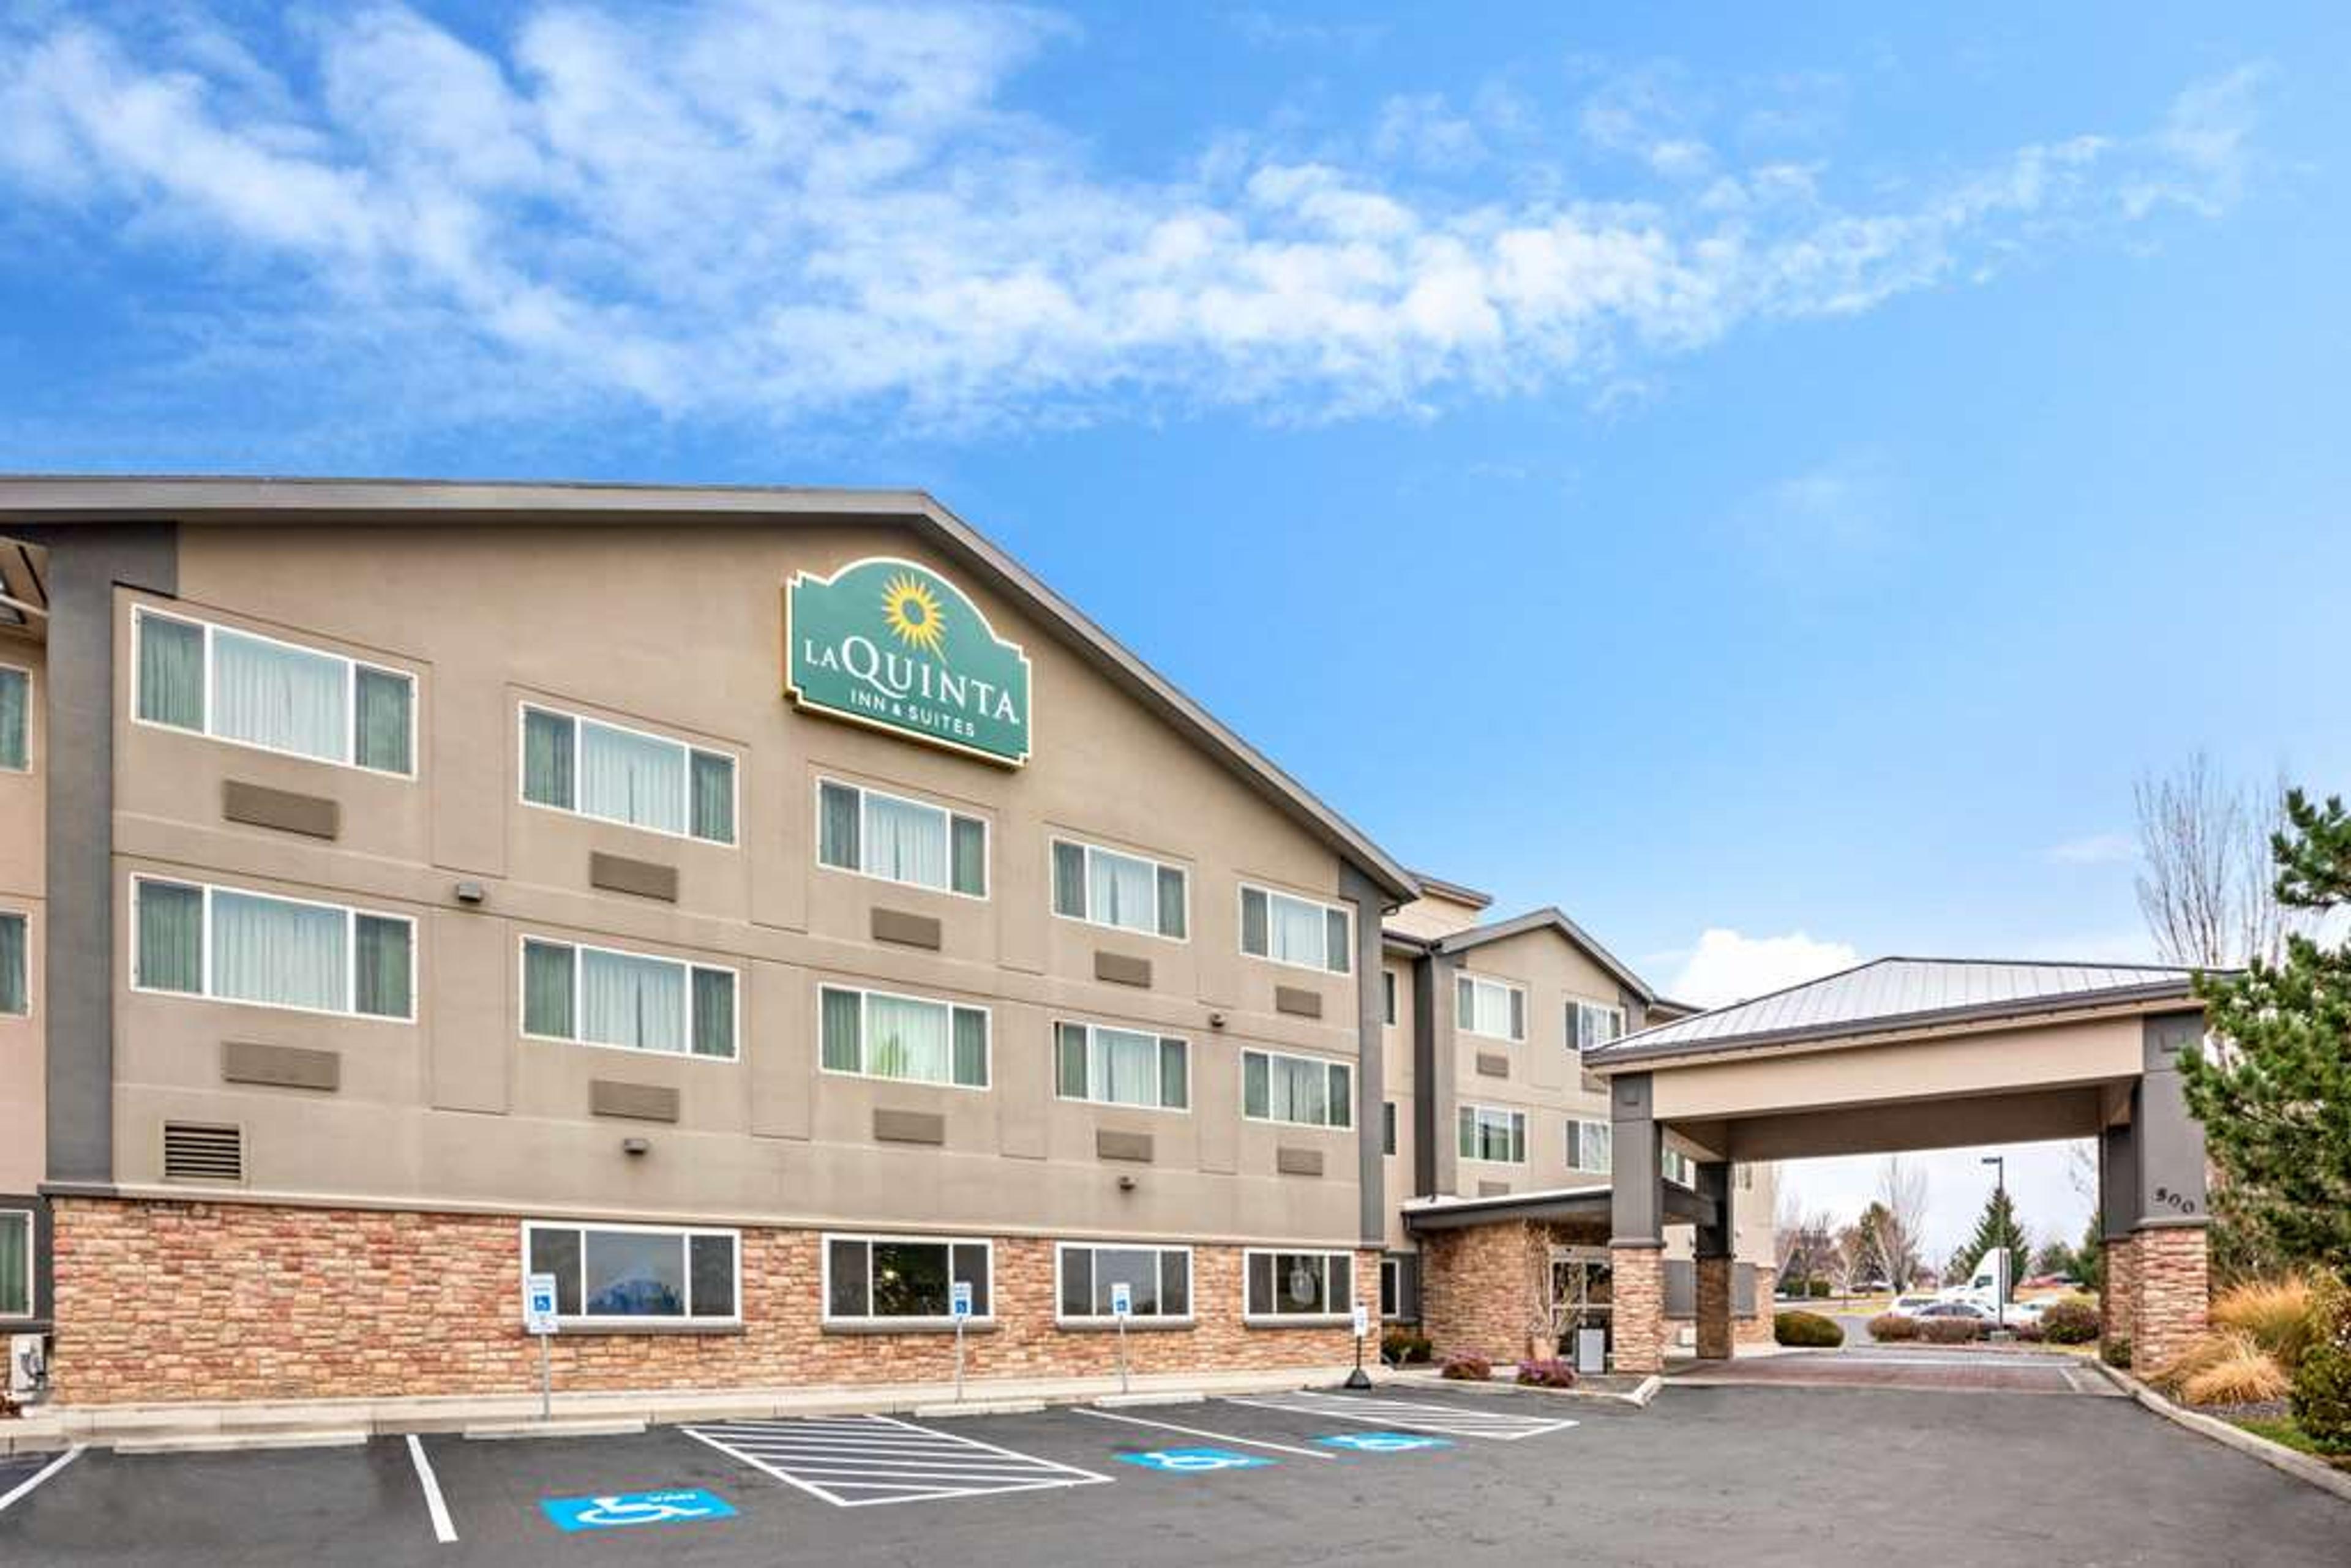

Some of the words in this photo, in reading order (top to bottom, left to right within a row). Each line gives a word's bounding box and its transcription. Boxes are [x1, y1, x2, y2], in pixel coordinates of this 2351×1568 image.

[804, 638, 839, 671] LA
[842, 636, 1021, 724] QUINTA
[851, 688, 886, 712] INN
[892, 702, 902, 717] &
[909, 704, 975, 738] SUITES
